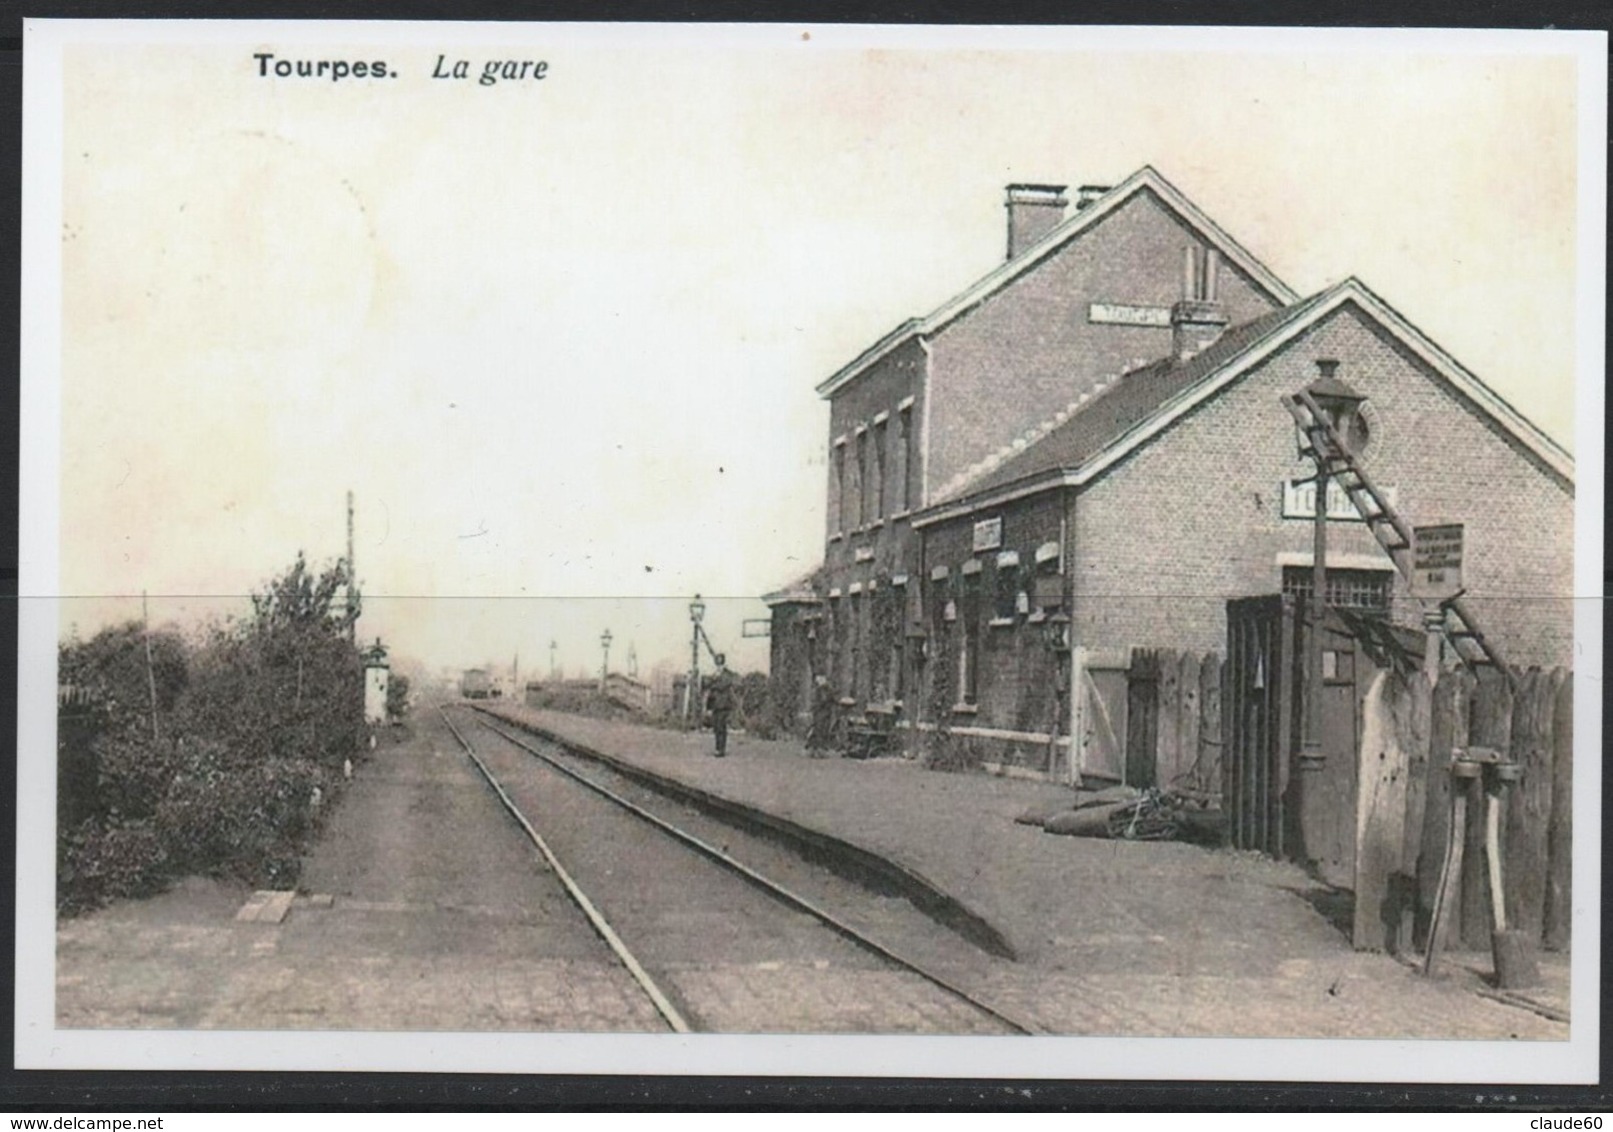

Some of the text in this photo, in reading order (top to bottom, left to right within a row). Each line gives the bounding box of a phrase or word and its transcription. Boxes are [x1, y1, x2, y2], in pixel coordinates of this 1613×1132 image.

[253, 53, 548, 85] Tourpes. La gare
